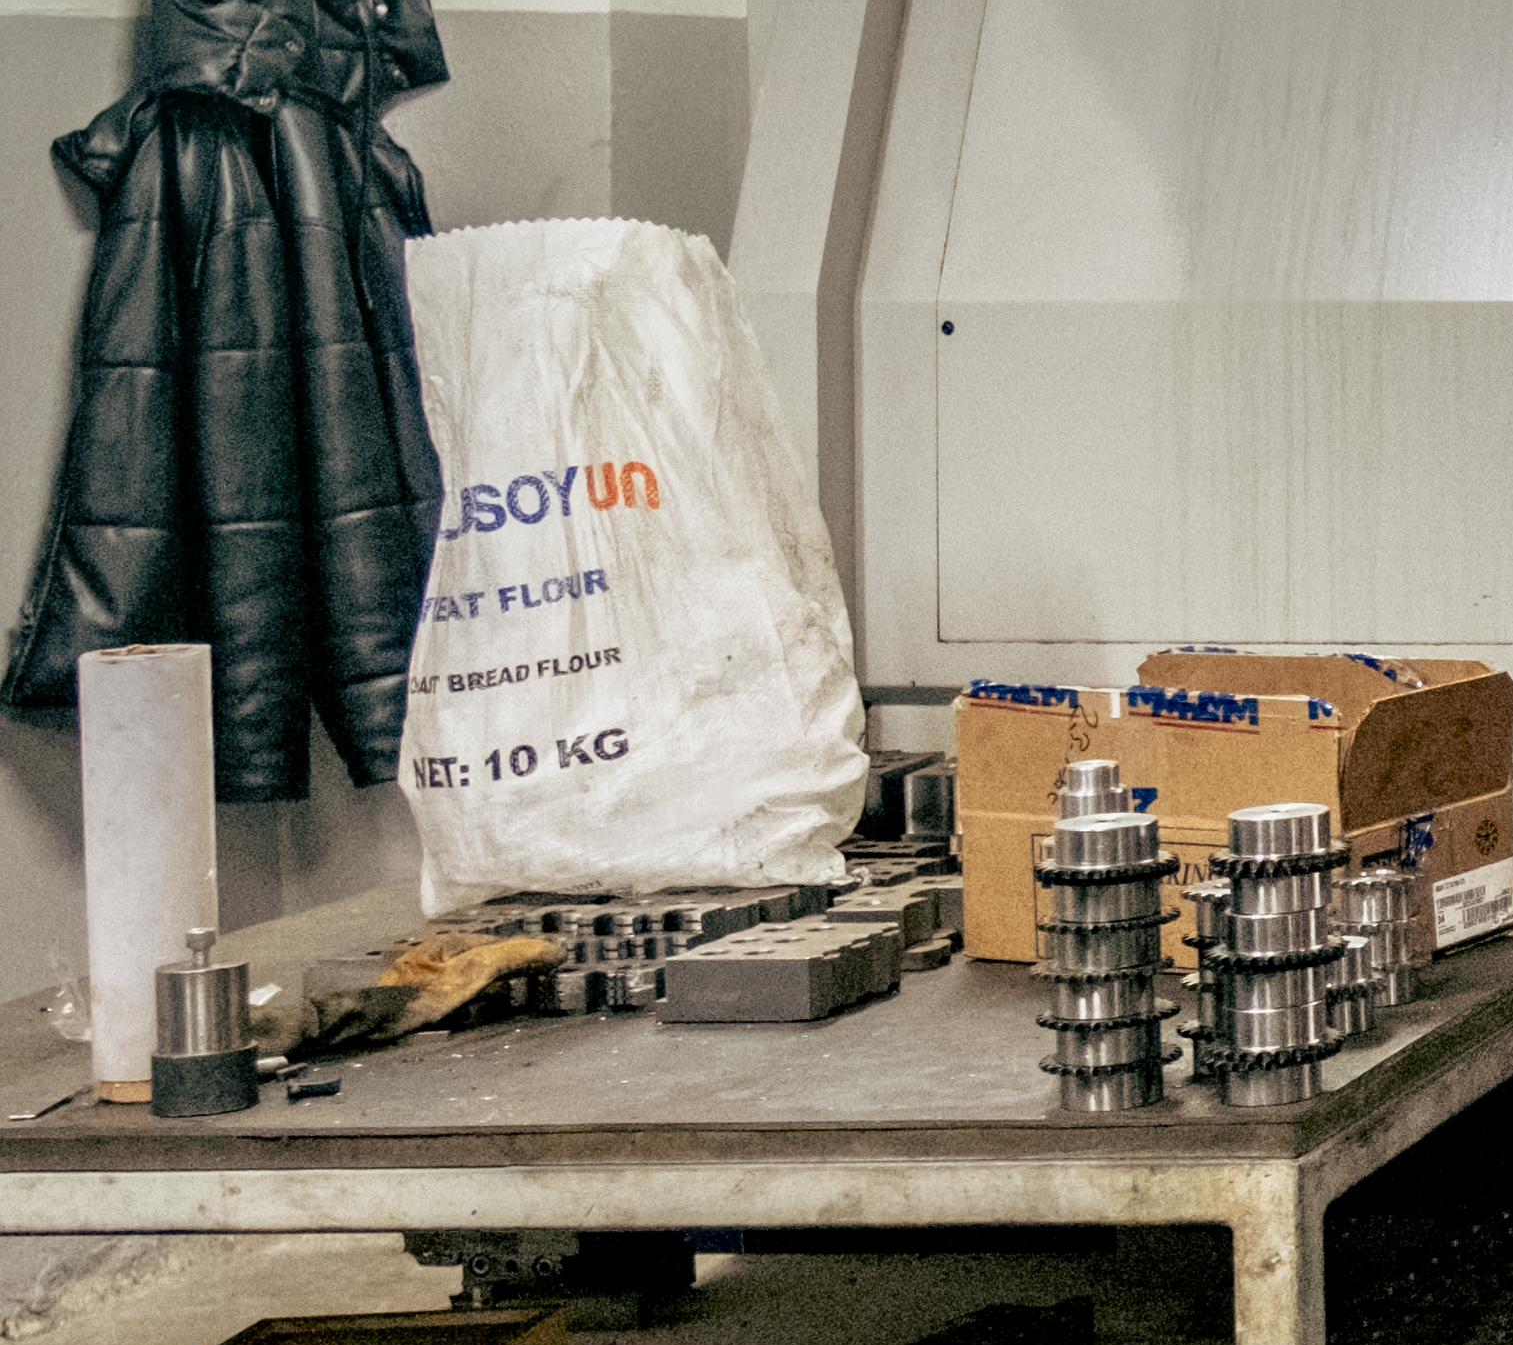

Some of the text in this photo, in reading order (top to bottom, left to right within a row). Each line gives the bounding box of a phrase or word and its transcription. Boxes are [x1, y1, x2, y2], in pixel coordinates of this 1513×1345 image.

[498, 568, 610, 613] FLOUR
[450, 664, 530, 693] BREAD
[537, 647, 622, 678] FLOUR
[413, 728, 630, 789] NET: 10 KG
